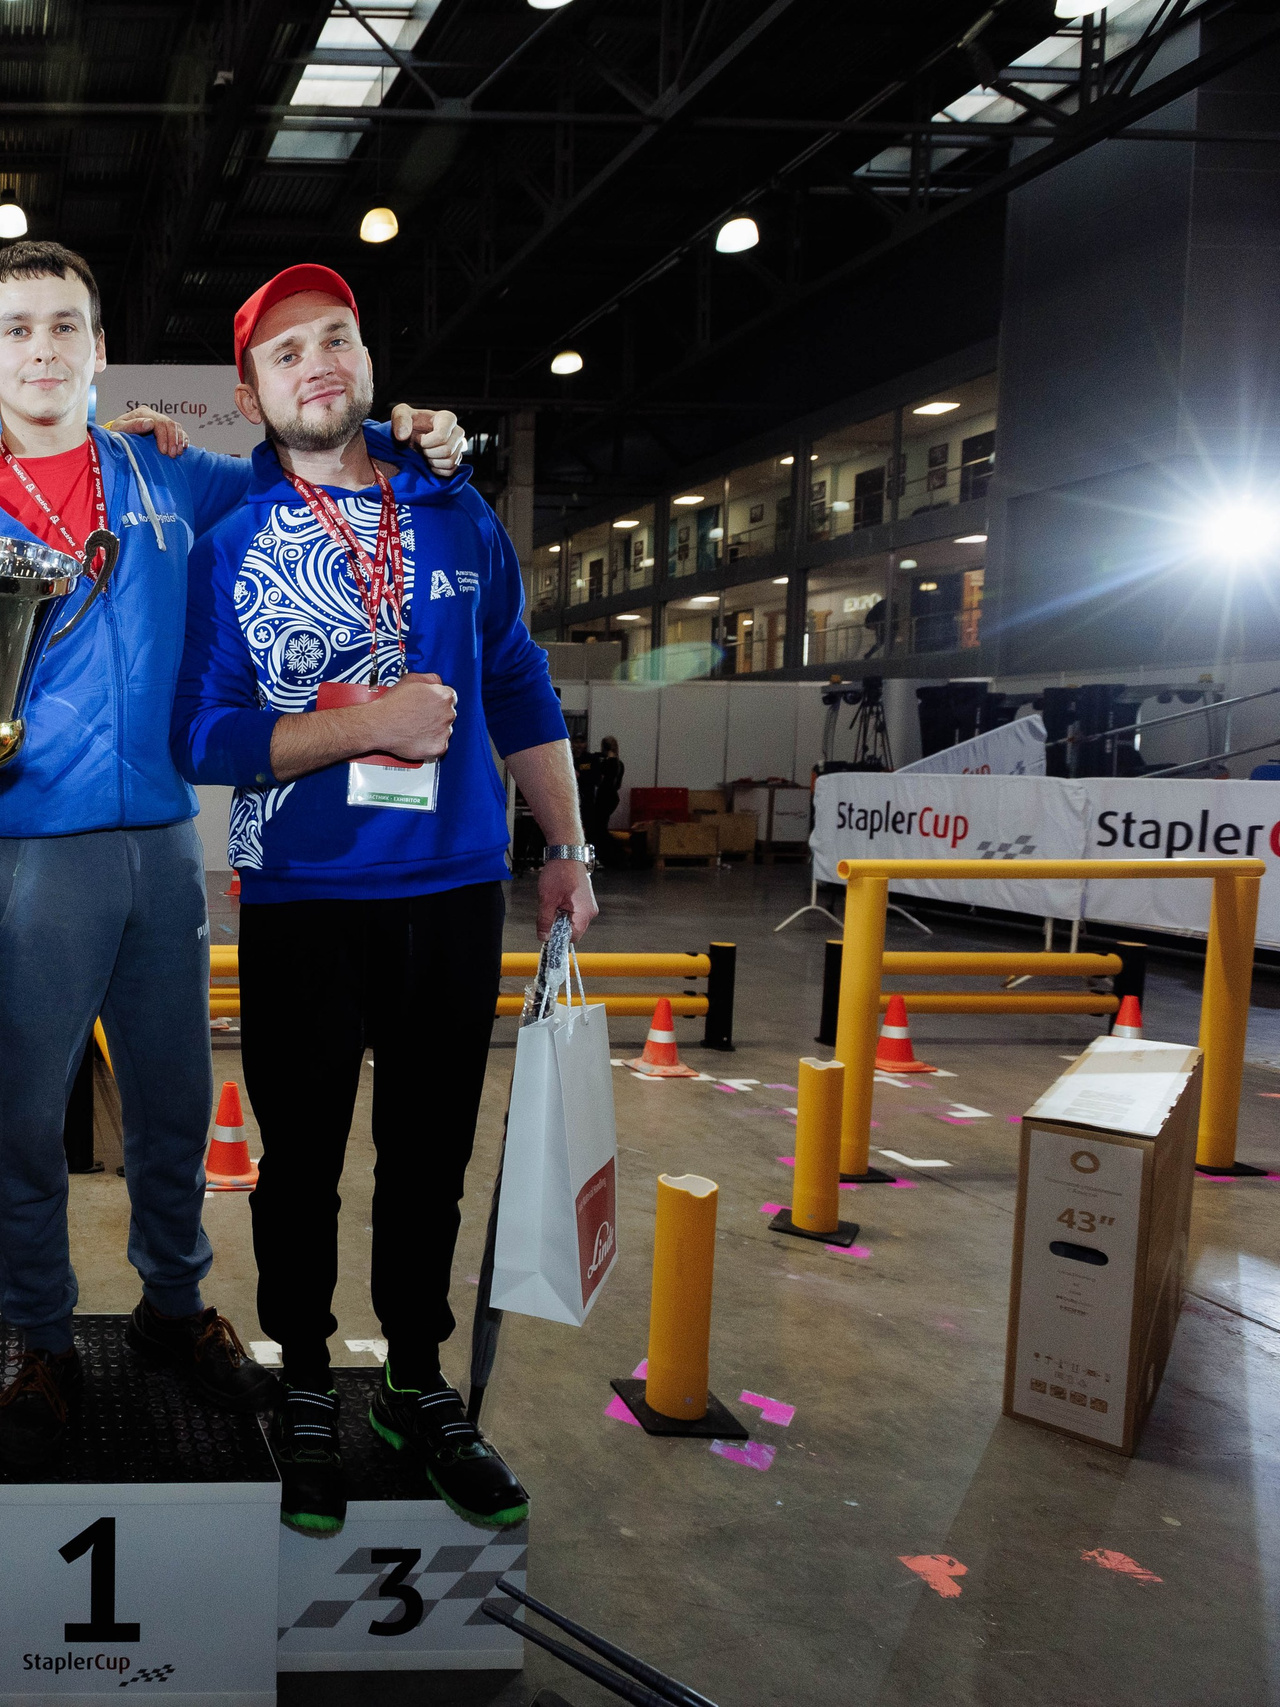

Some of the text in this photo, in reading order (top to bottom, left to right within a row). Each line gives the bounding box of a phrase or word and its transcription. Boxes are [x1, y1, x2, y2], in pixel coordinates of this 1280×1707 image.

[126, 399, 207, 418] StplerCup
[837, 801, 969, 848] StaplerCup
[587, 1221, 614, 1279] Linde
[57, 1516, 141, 1642] 1
[367, 1548, 424, 1637] 3
[23, 1651, 131, 1675] StaplerCup
